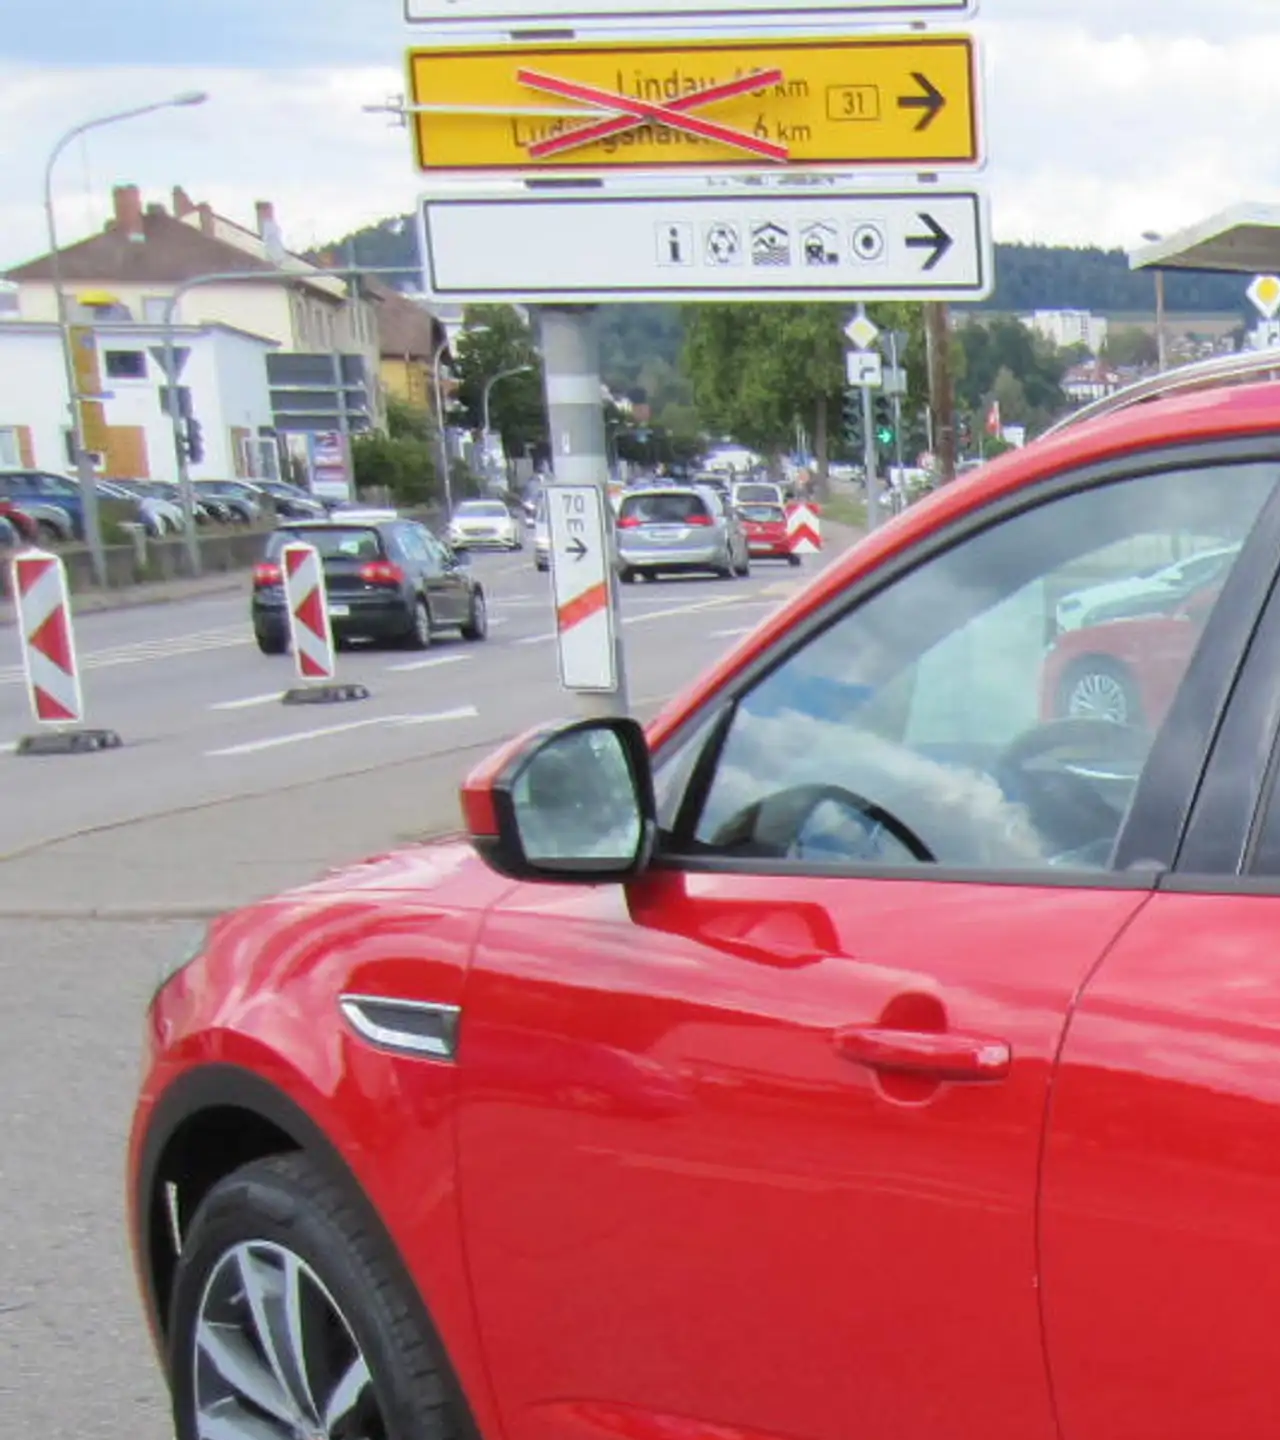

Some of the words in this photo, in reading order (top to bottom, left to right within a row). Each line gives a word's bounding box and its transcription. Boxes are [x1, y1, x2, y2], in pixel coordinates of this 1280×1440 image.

[842, 91, 864, 114] 31
[777, 121, 811, 141] km
[562, 495, 585, 514] 70
